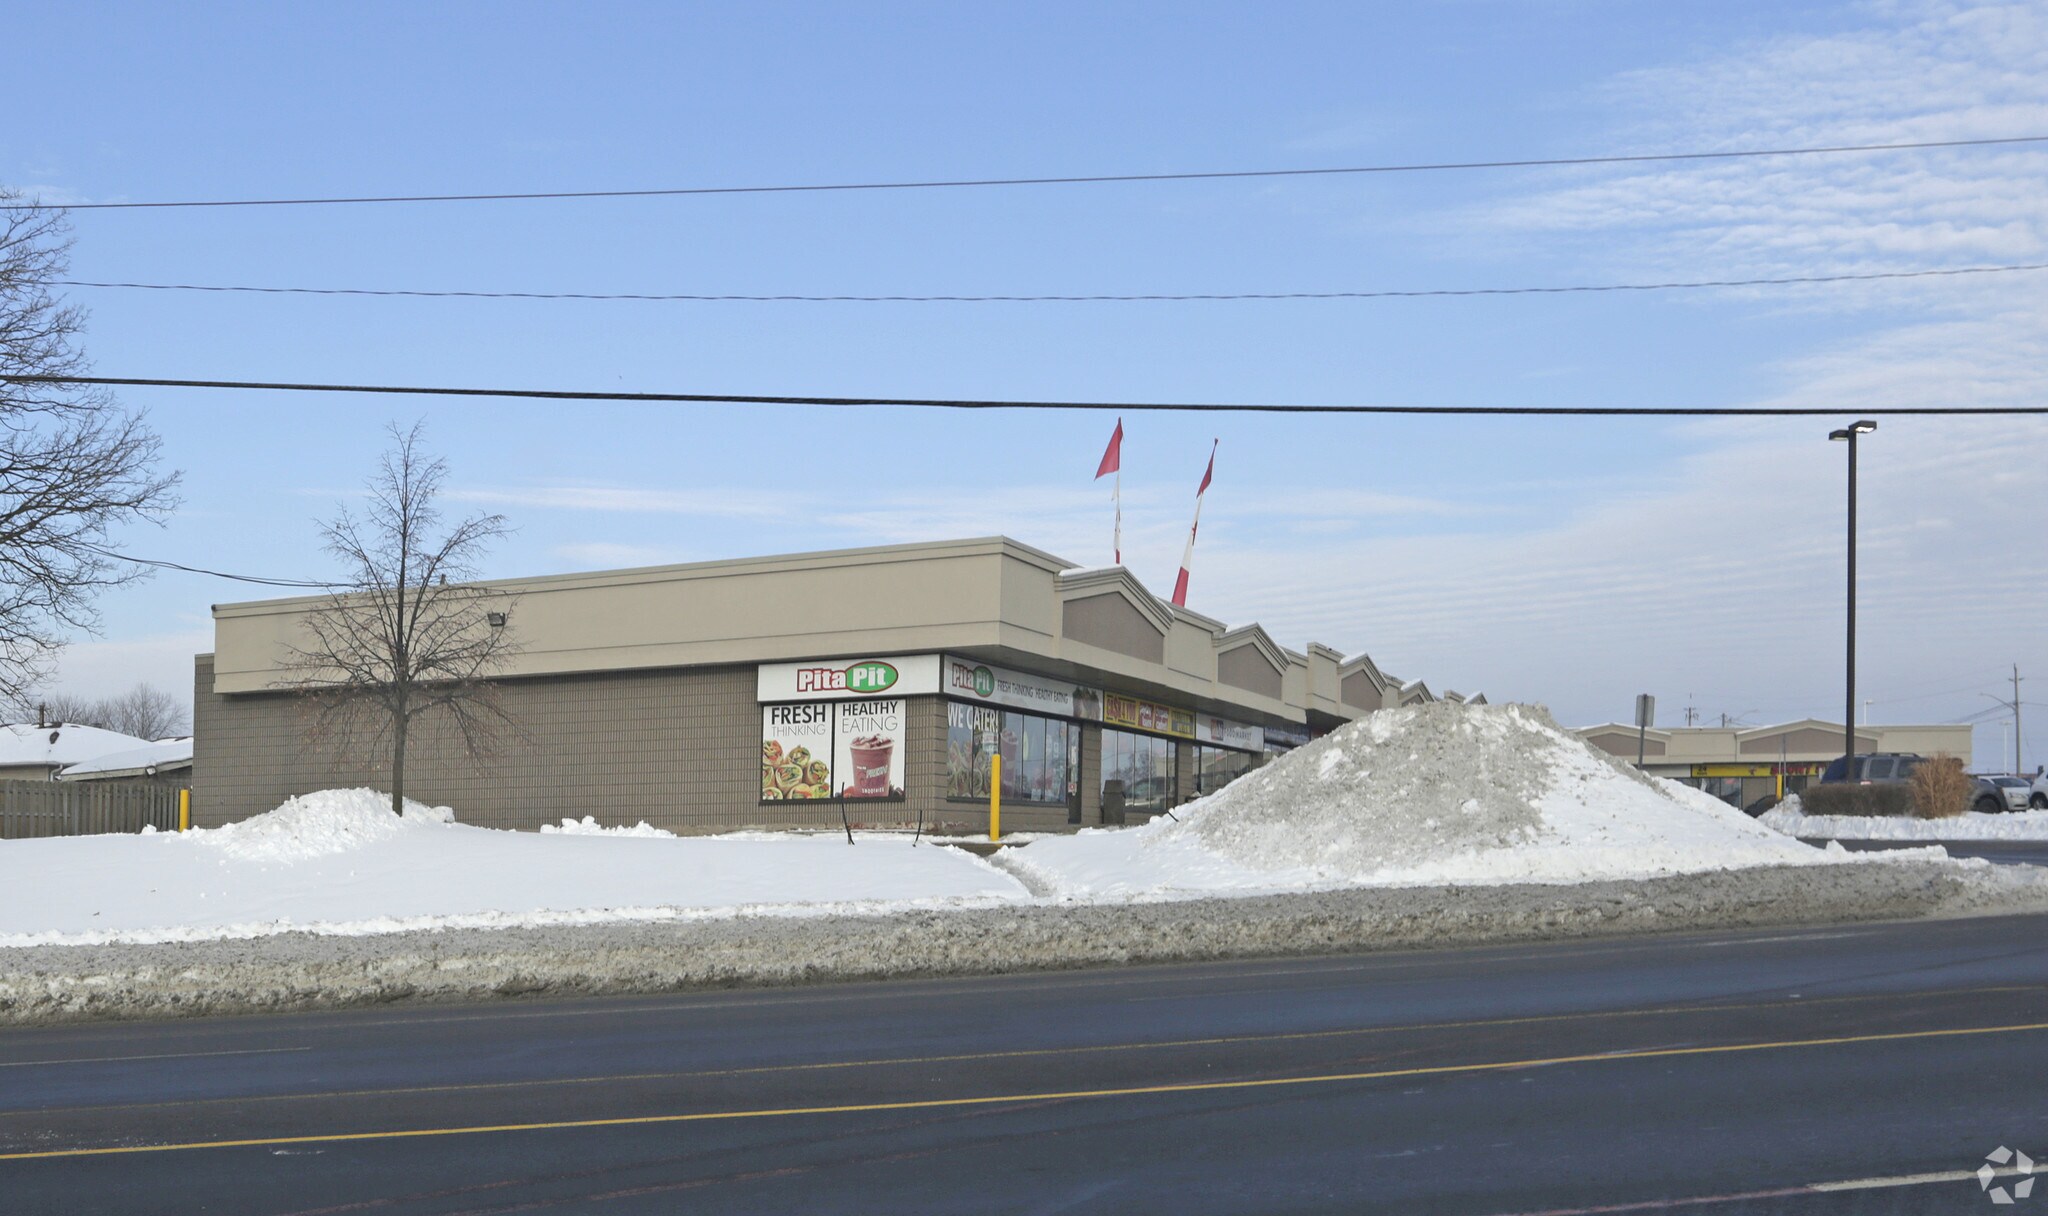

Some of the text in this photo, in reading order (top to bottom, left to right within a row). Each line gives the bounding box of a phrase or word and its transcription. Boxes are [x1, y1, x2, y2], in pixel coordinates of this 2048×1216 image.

[797, 667, 886, 692] Pita Pit
[952, 663, 991, 692] Pita Pit
[997, 679, 1069, 704] FRESH THINKING HEALTHY EATING
[771, 704, 826, 725] FRESH
[842, 701, 899, 717] HEALTHY
[947, 701, 999, 733] WE CATER!
[772, 724, 826, 738] THINKING
[842, 716, 898, 734] EATING
